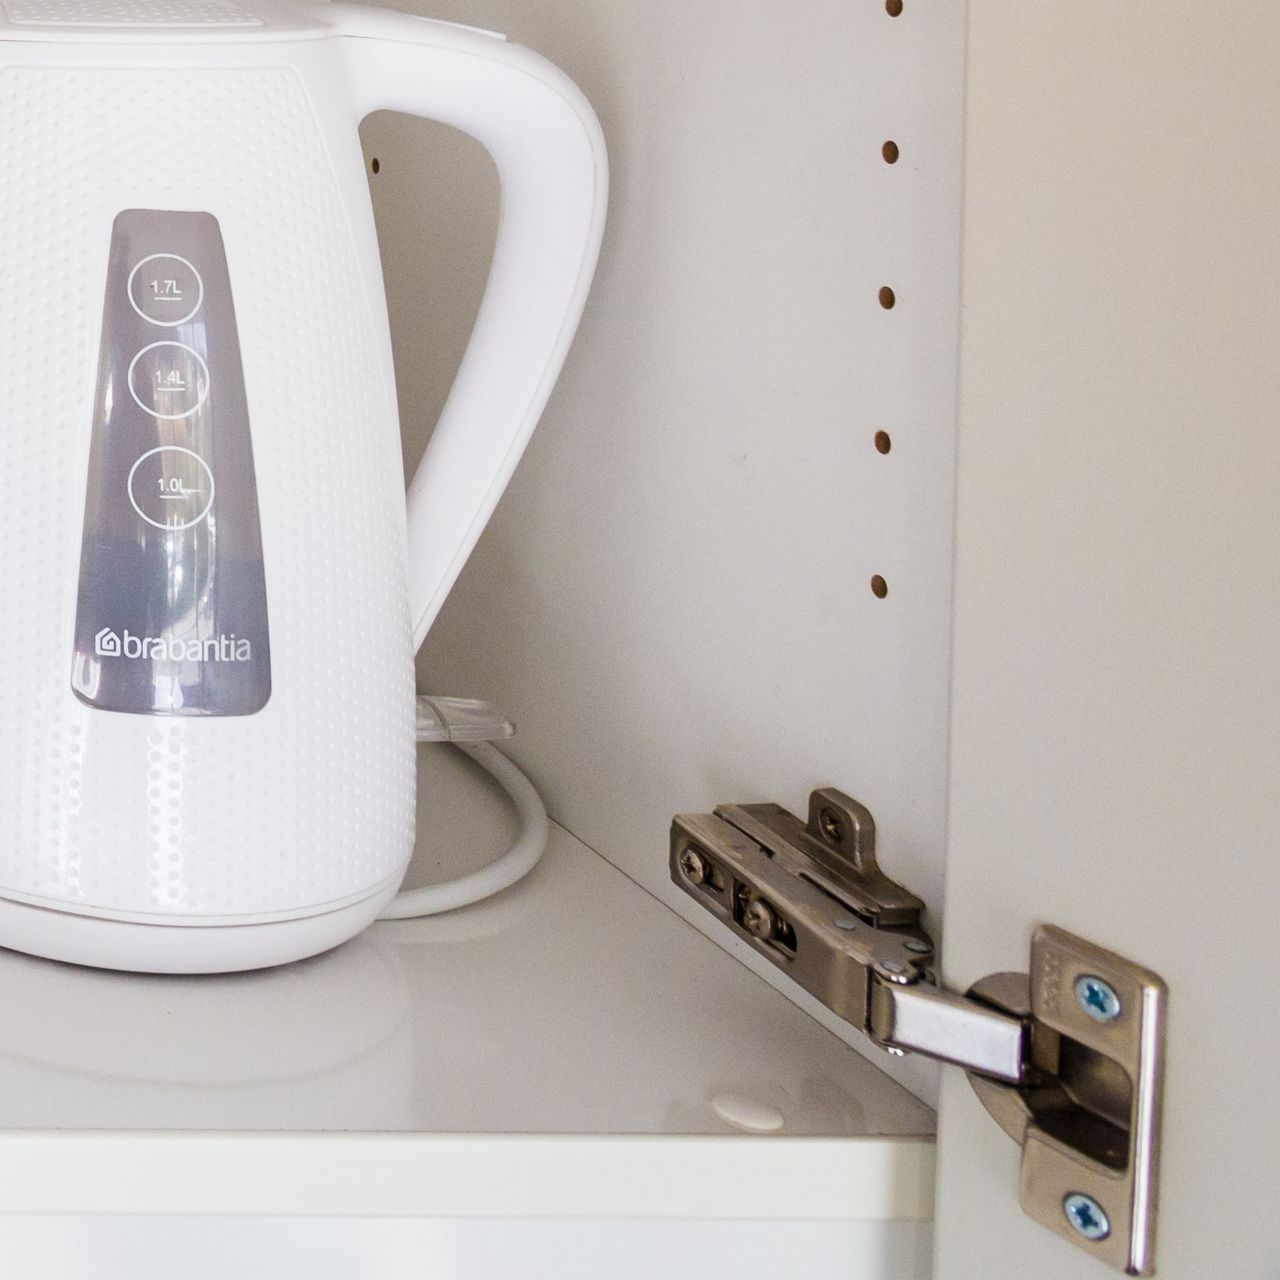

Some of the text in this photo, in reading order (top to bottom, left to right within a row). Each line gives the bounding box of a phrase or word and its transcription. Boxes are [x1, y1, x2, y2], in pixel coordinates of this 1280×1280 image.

[151, 280, 182, 294] 1.7L
[155, 370, 185, 385] 1.4L
[123, 629, 251, 662] brabantia
